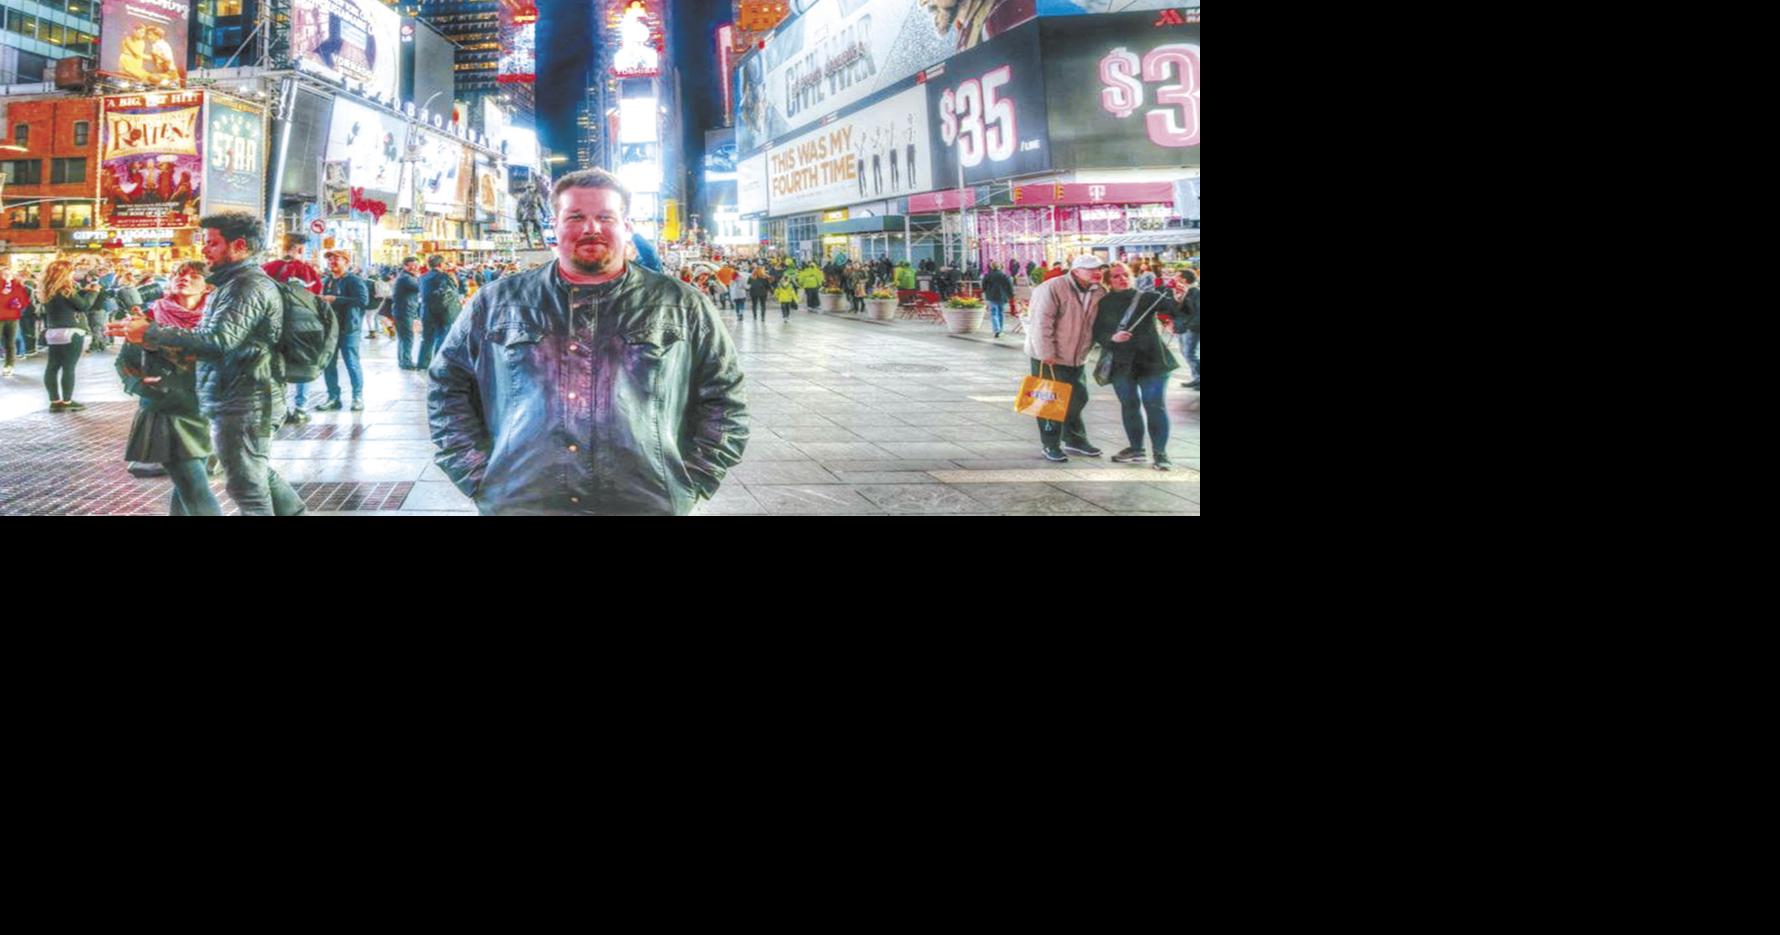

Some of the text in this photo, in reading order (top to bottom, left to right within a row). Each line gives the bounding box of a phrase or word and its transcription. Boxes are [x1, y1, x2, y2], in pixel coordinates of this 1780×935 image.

[939, 64, 1017, 168] $35
[211, 131, 257, 171] STAR
[771, 125, 853, 175] THIS WAS MY
[772, 153, 857, 197] FOURTH TIME
